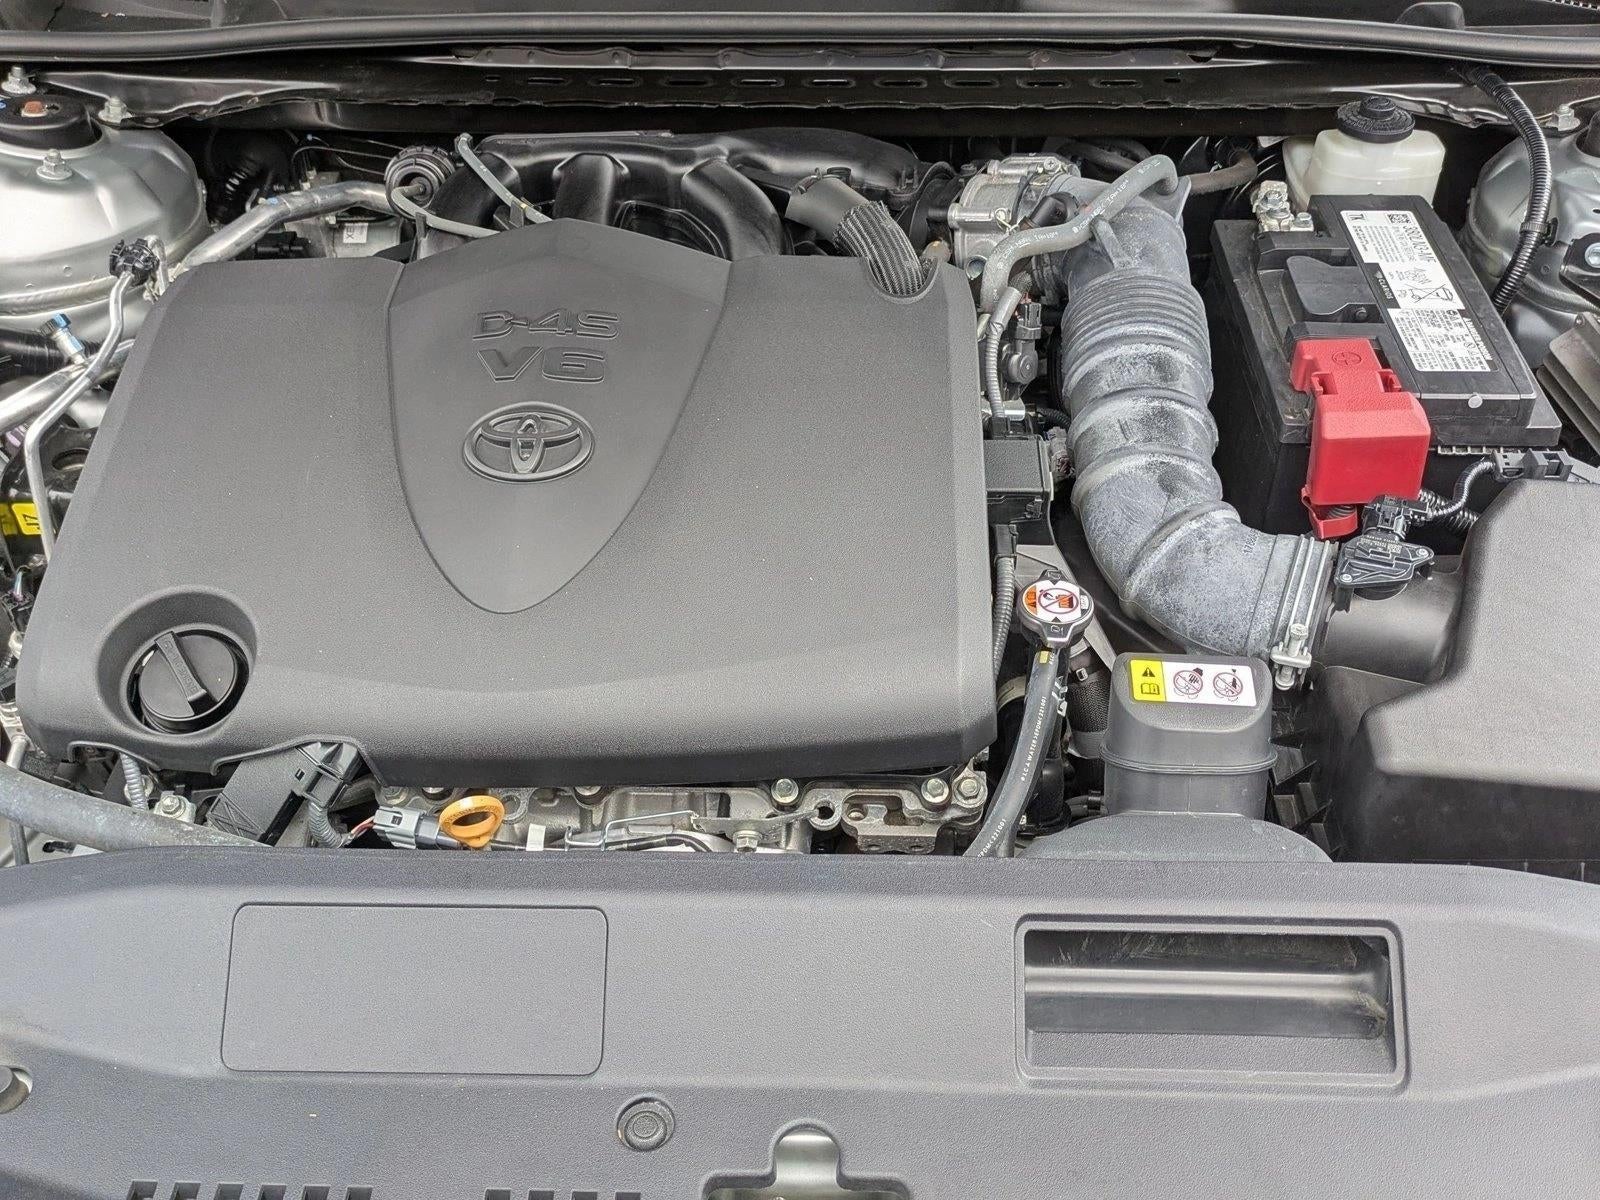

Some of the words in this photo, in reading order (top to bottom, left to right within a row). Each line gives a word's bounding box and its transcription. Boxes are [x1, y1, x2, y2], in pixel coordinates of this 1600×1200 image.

[1378, 278, 1394, 300] CLARIOS
[472, 309, 620, 340] D-4S
[476, 345, 606, 384] V6
